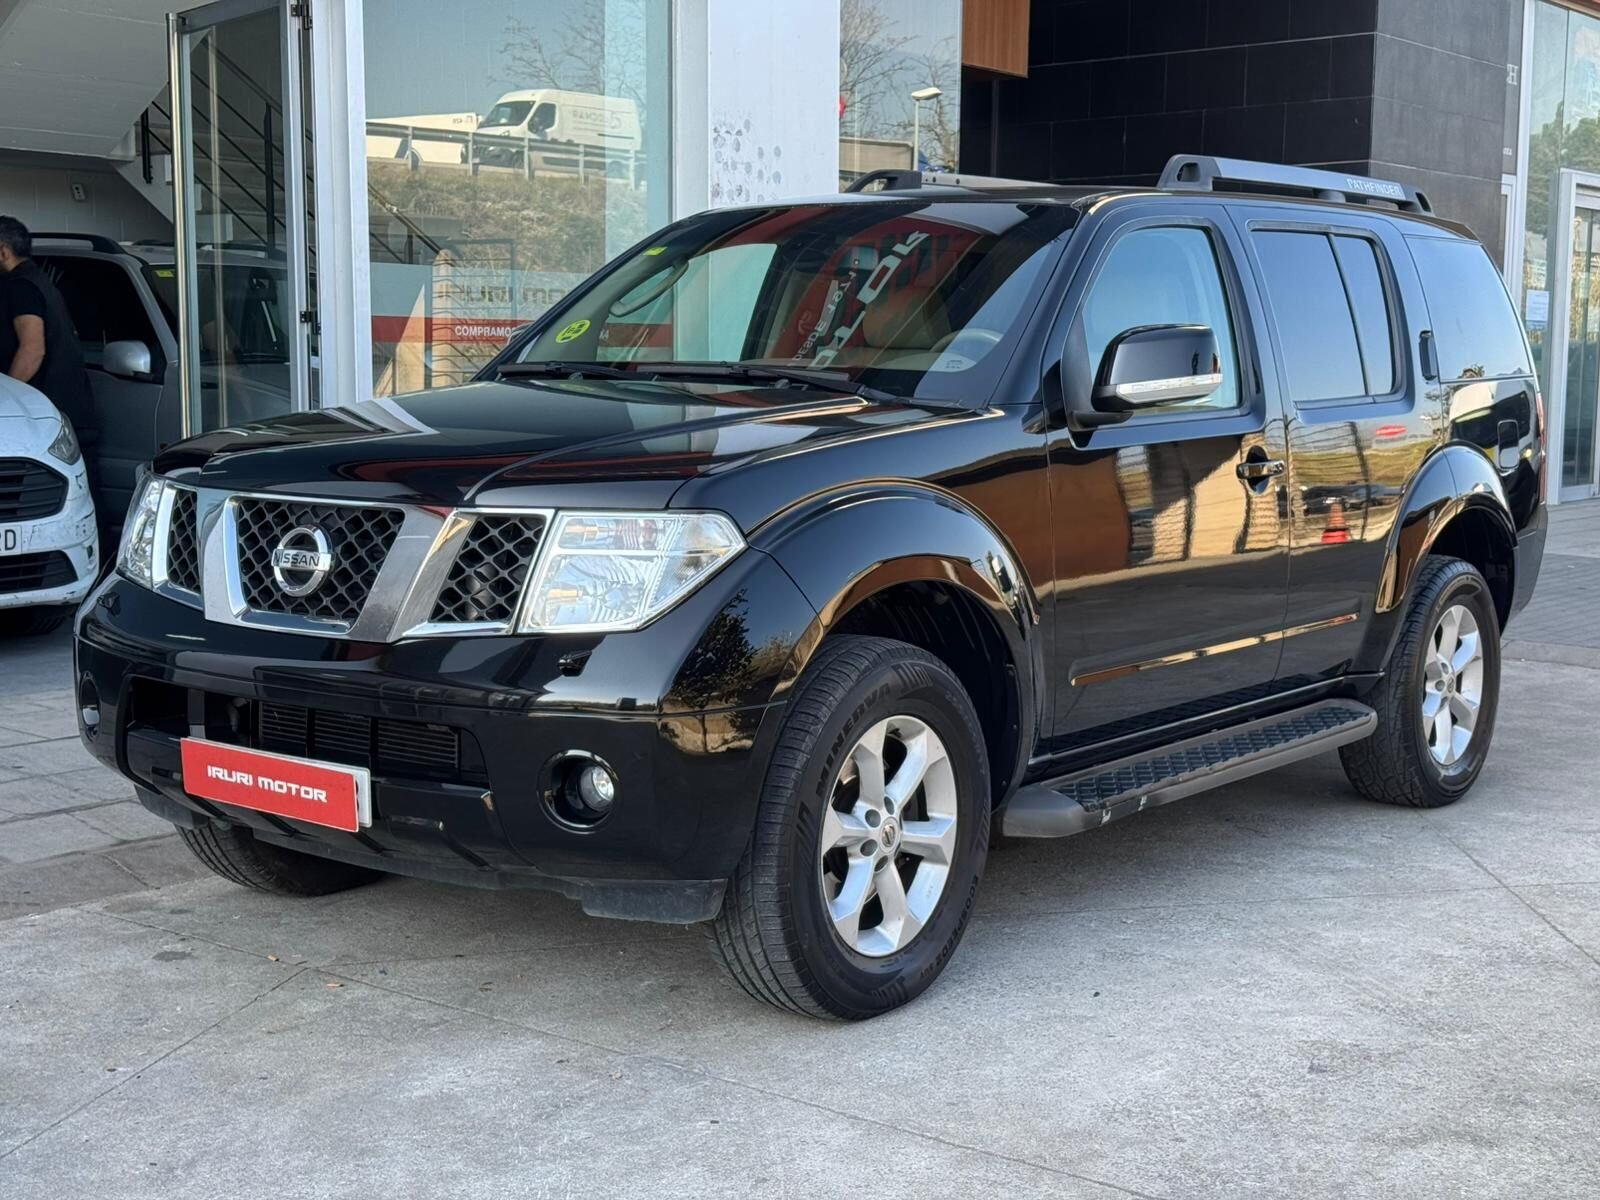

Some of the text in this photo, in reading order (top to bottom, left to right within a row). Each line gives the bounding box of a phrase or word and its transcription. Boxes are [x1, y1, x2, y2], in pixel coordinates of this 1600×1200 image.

[1346, 178, 1403, 196] PATHFINDER
[0, 527, 17, 551] D
[274, 549, 320, 567] NISSAN
[815, 682, 891, 798] MINERVA
[206, 764, 328, 803] IRURI MOTOR
